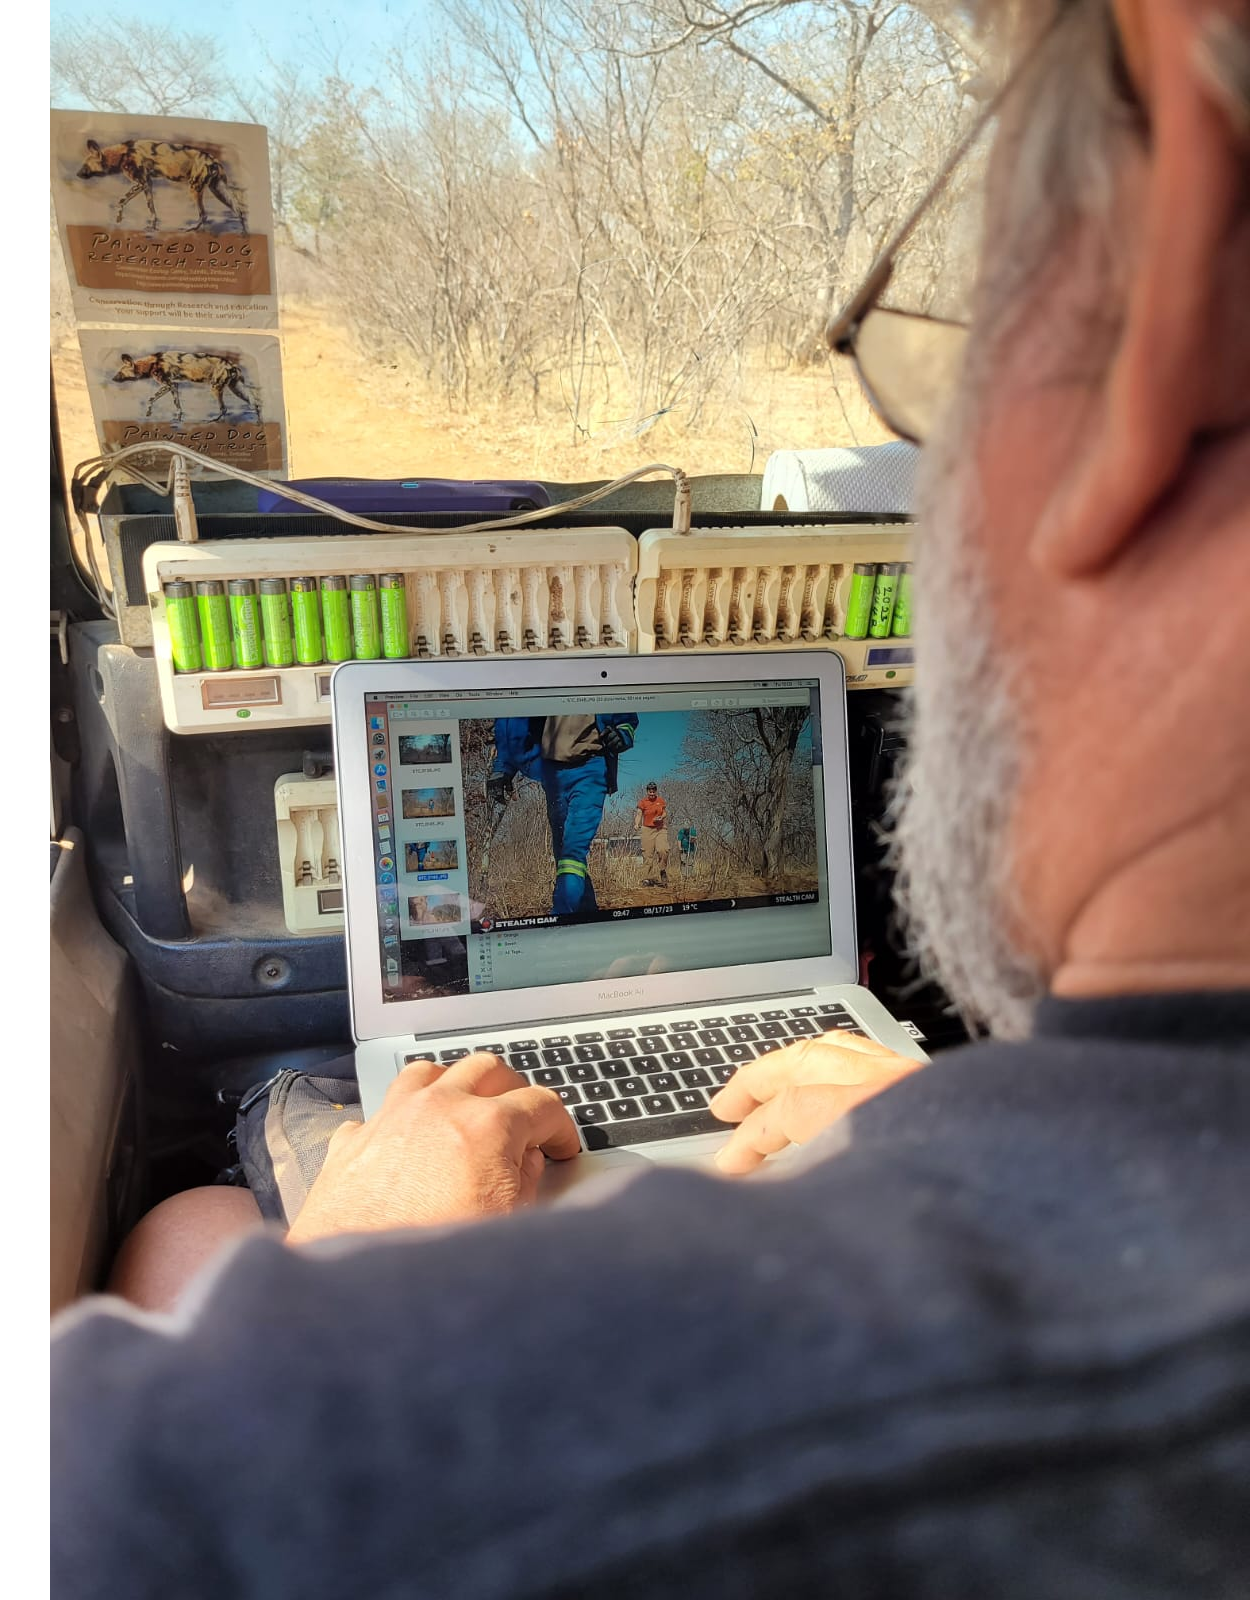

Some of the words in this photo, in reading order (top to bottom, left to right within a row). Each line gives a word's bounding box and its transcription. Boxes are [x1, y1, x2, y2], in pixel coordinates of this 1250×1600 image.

[88, 251, 187, 268] RESEARCH
[196, 258, 255, 270] TRUST
[177, 302, 213, 310] Research
[136, 309, 167, 318] support
[183, 310, 194, 318] be
[217, 443, 267, 452] TRUST
[775, 895, 801, 903] STEALTH
[495, 918, 536, 928] STEALTH
[536, 916, 558, 924] CAM
[598, 990, 632, 1000] MacBook
[626, 1082, 635, 1090] G
